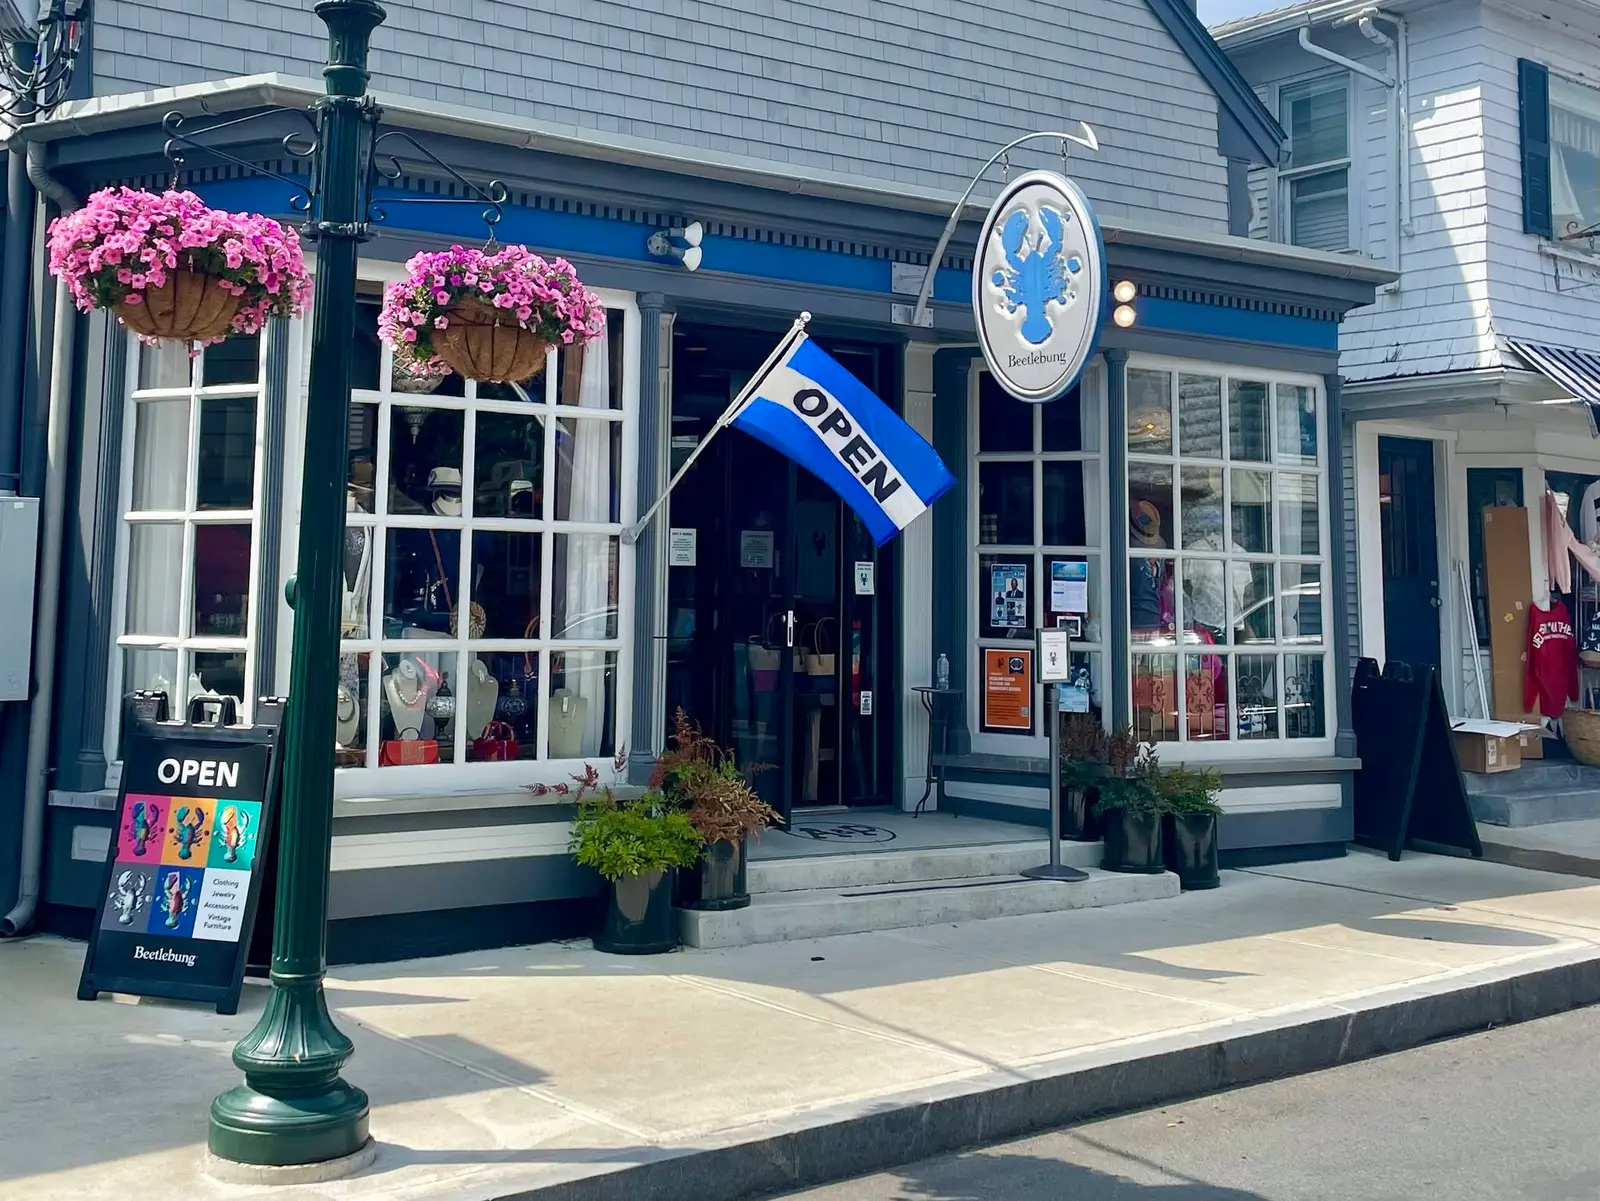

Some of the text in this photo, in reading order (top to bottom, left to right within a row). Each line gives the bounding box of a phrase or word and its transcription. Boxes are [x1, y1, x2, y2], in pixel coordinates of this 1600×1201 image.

[1007, 350, 1067, 368] Beetlebung
[792, 388, 902, 504] OPEN
[157, 757, 240, 788] OPEN
[212, 878, 240, 889] Clothing
[211, 890, 237, 901] Jewelry
[203, 901, 240, 912] Accessories
[207, 913, 232, 924] Vintage
[203, 921, 232, 931] Furniture
[133, 945, 197, 967] Beetlebung
